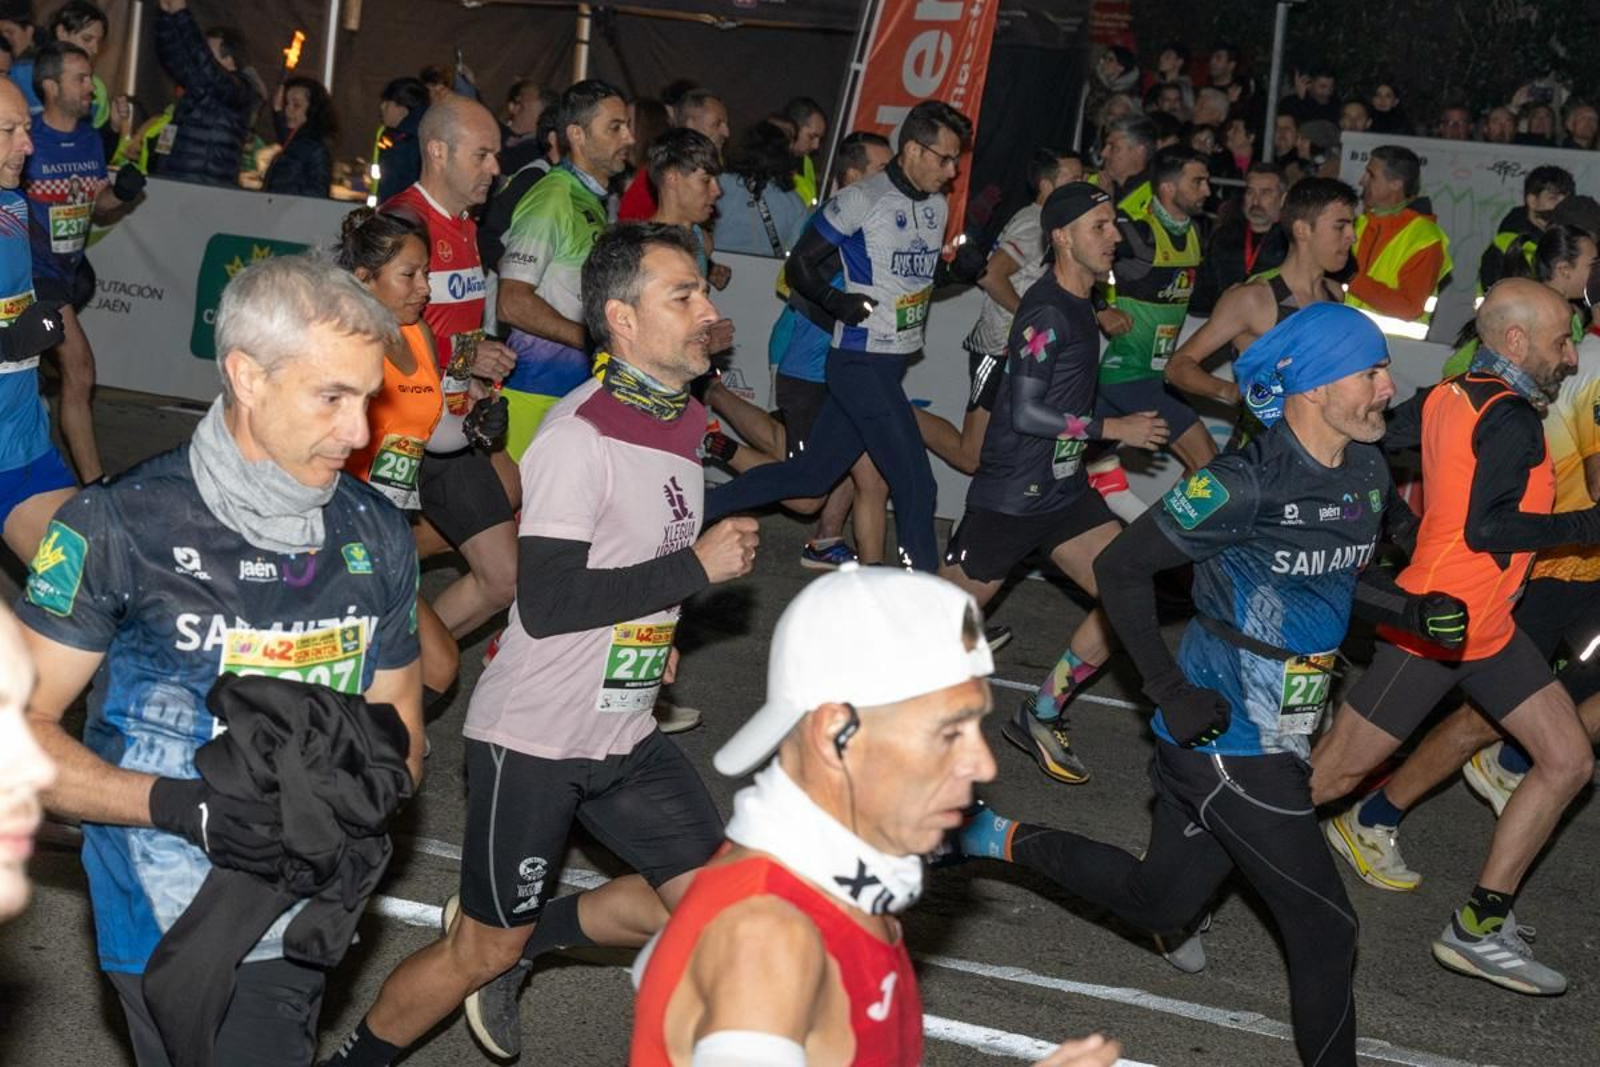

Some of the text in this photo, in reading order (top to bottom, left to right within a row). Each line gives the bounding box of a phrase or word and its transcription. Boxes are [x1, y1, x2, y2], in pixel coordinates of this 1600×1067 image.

[239, 556, 278, 580] jaén
[1271, 549, 1326, 576] SAN
[262, 640, 294, 661] 42
